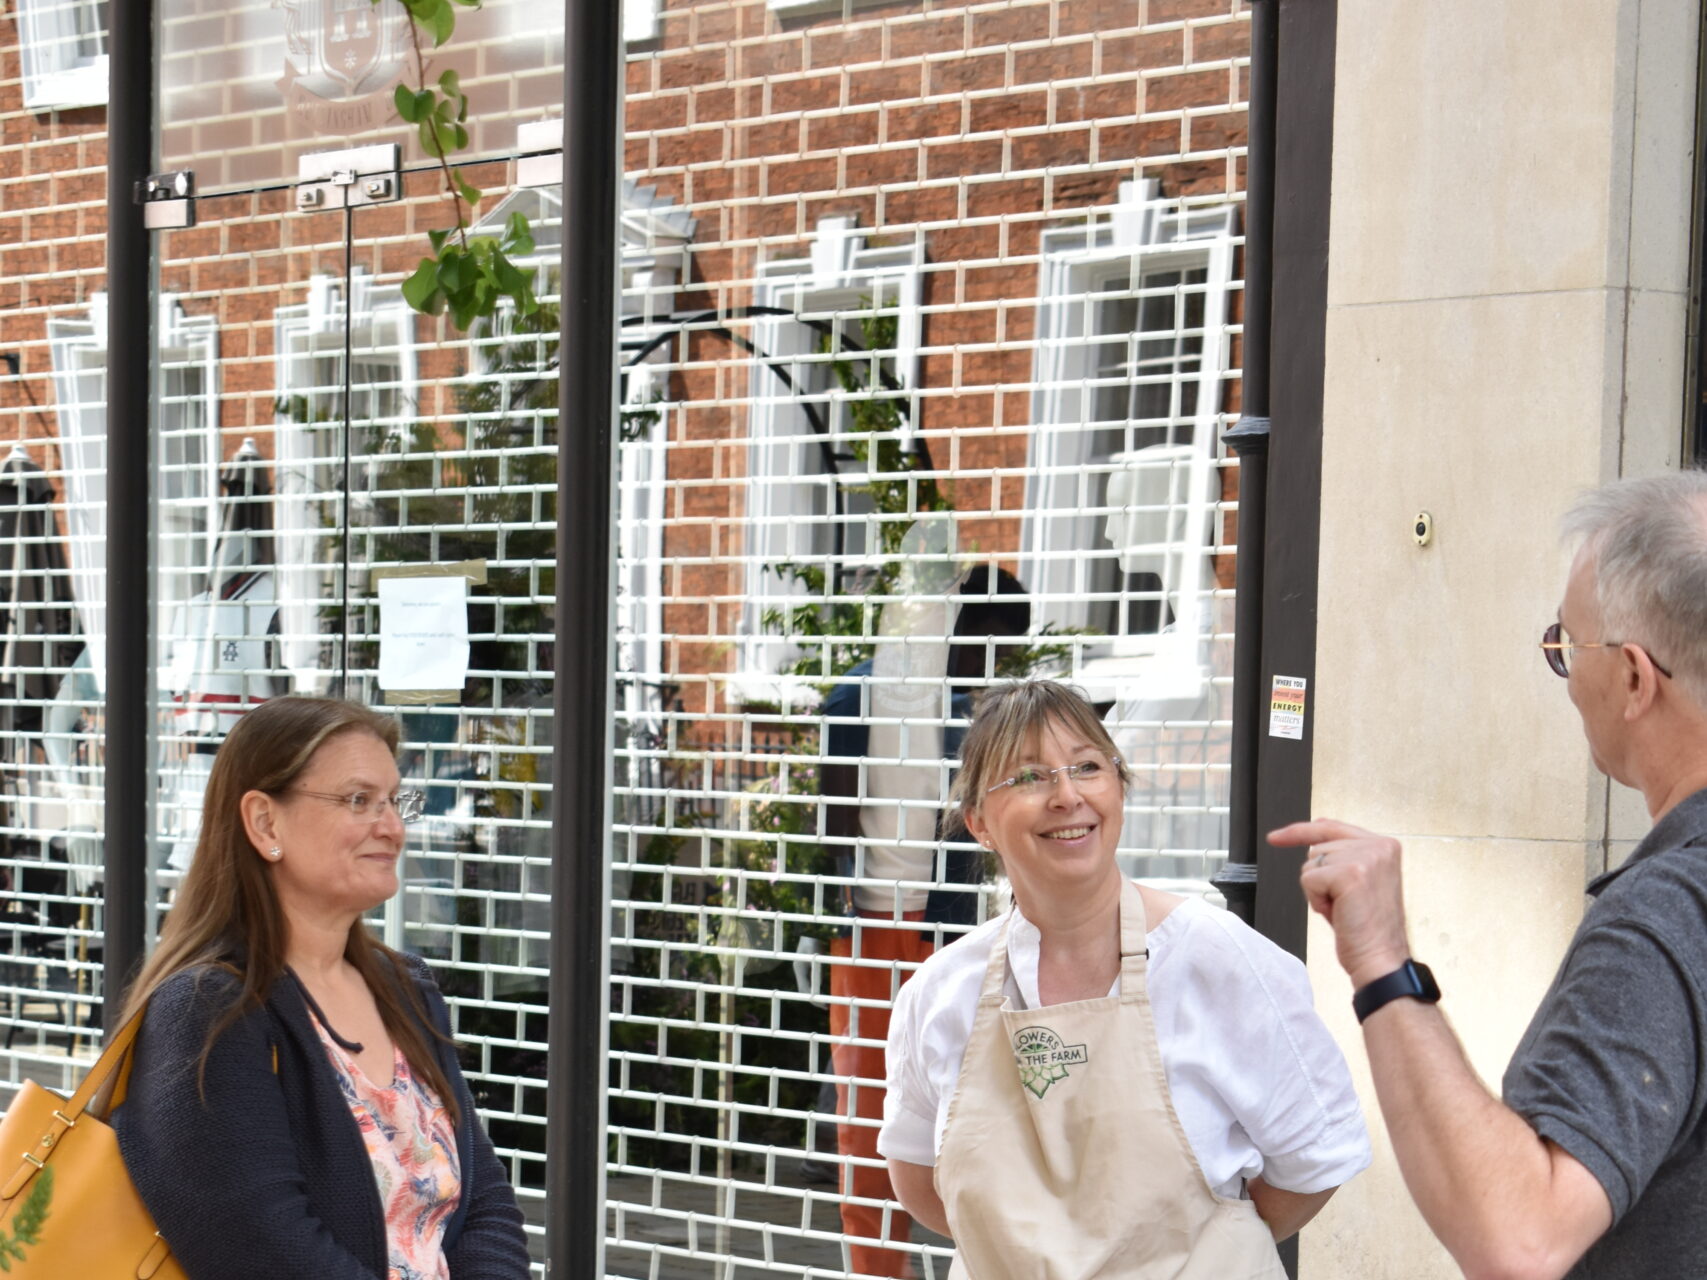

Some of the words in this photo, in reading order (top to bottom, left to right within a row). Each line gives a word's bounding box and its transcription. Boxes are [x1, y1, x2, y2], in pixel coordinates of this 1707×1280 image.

[1276, 679, 1291, 687] WHERE
[1273, 702, 1302, 712] ENERGY
[1024, 1053, 1048, 1066] THE
[1051, 1049, 1082, 1063] FARM
